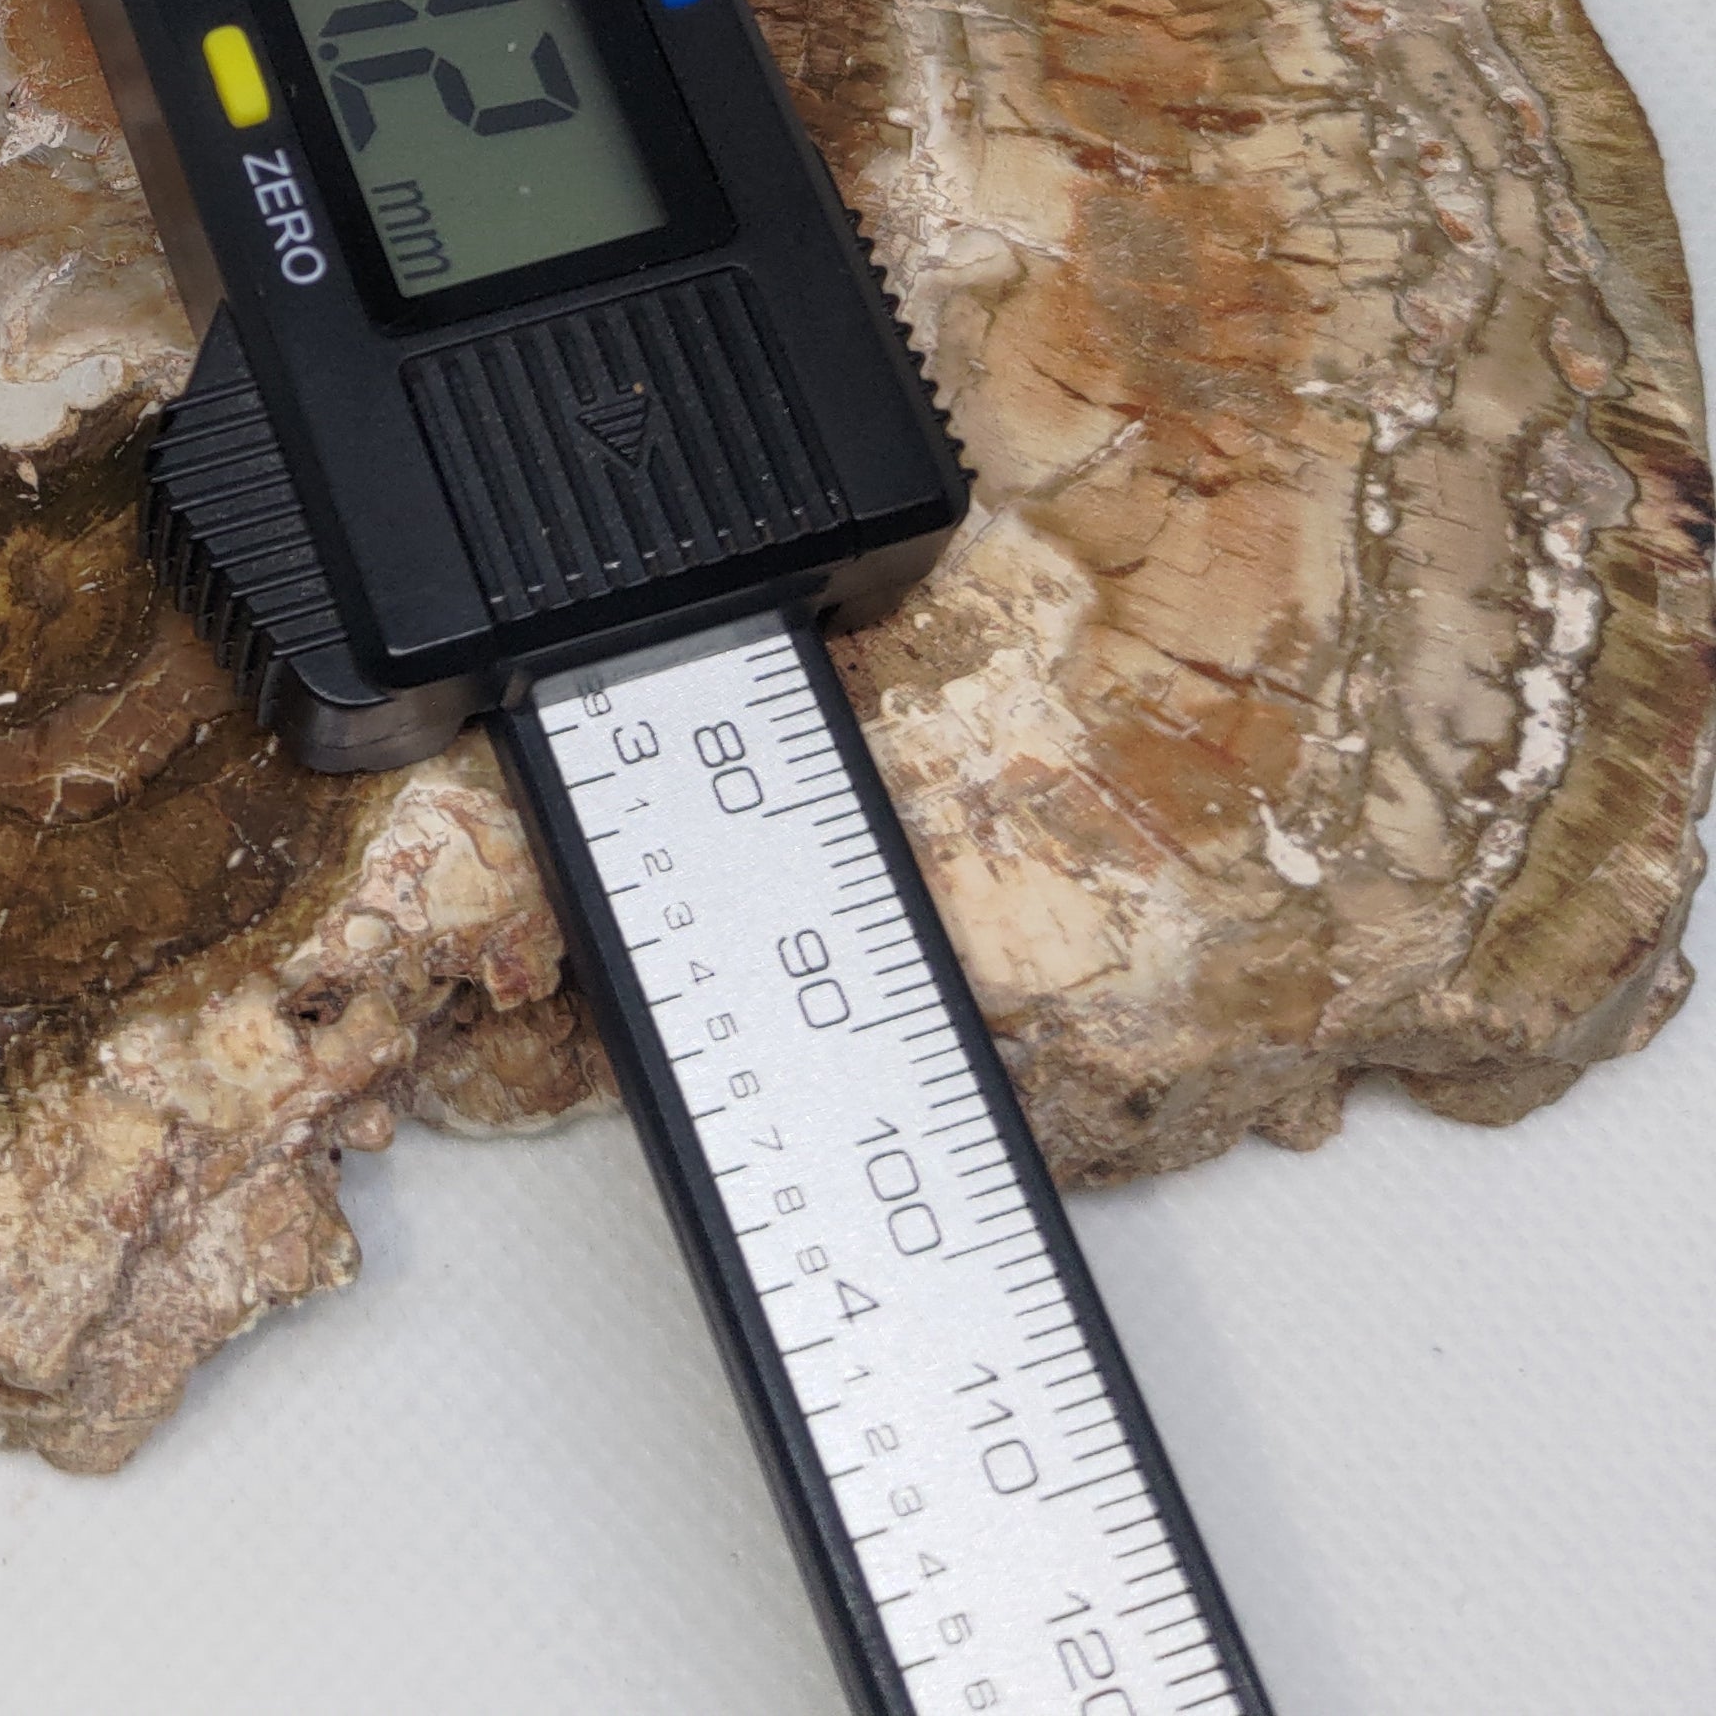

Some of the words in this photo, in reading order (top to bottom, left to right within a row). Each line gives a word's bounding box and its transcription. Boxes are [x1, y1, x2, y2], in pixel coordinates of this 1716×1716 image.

[242, 148, 327, 285] ZERO
[371, 180, 451, 280] mm
[613, 721, 659, 764] 3
[693, 720, 764, 814] 80
[778, 929, 850, 1029] 90
[625, 797, 650, 813] 1
[642, 848, 673, 877] 2
[663, 901, 695, 930] 3
[689, 959, 715, 983] 4
[706, 1012, 739, 1041] 5
[729, 1070, 760, 1100] 6
[751, 1125, 783, 1150] 7
[774, 1185, 806, 1215] 8
[837, 1279, 880, 1324] 4
[857, 1117, 942, 1256] 100
[844, 1365, 870, 1383] 1
[865, 1424, 900, 1456] 2
[888, 1485, 924, 1517] 3
[918, 1551, 947, 1579] 4
[955, 1363, 1039, 1495] 110
